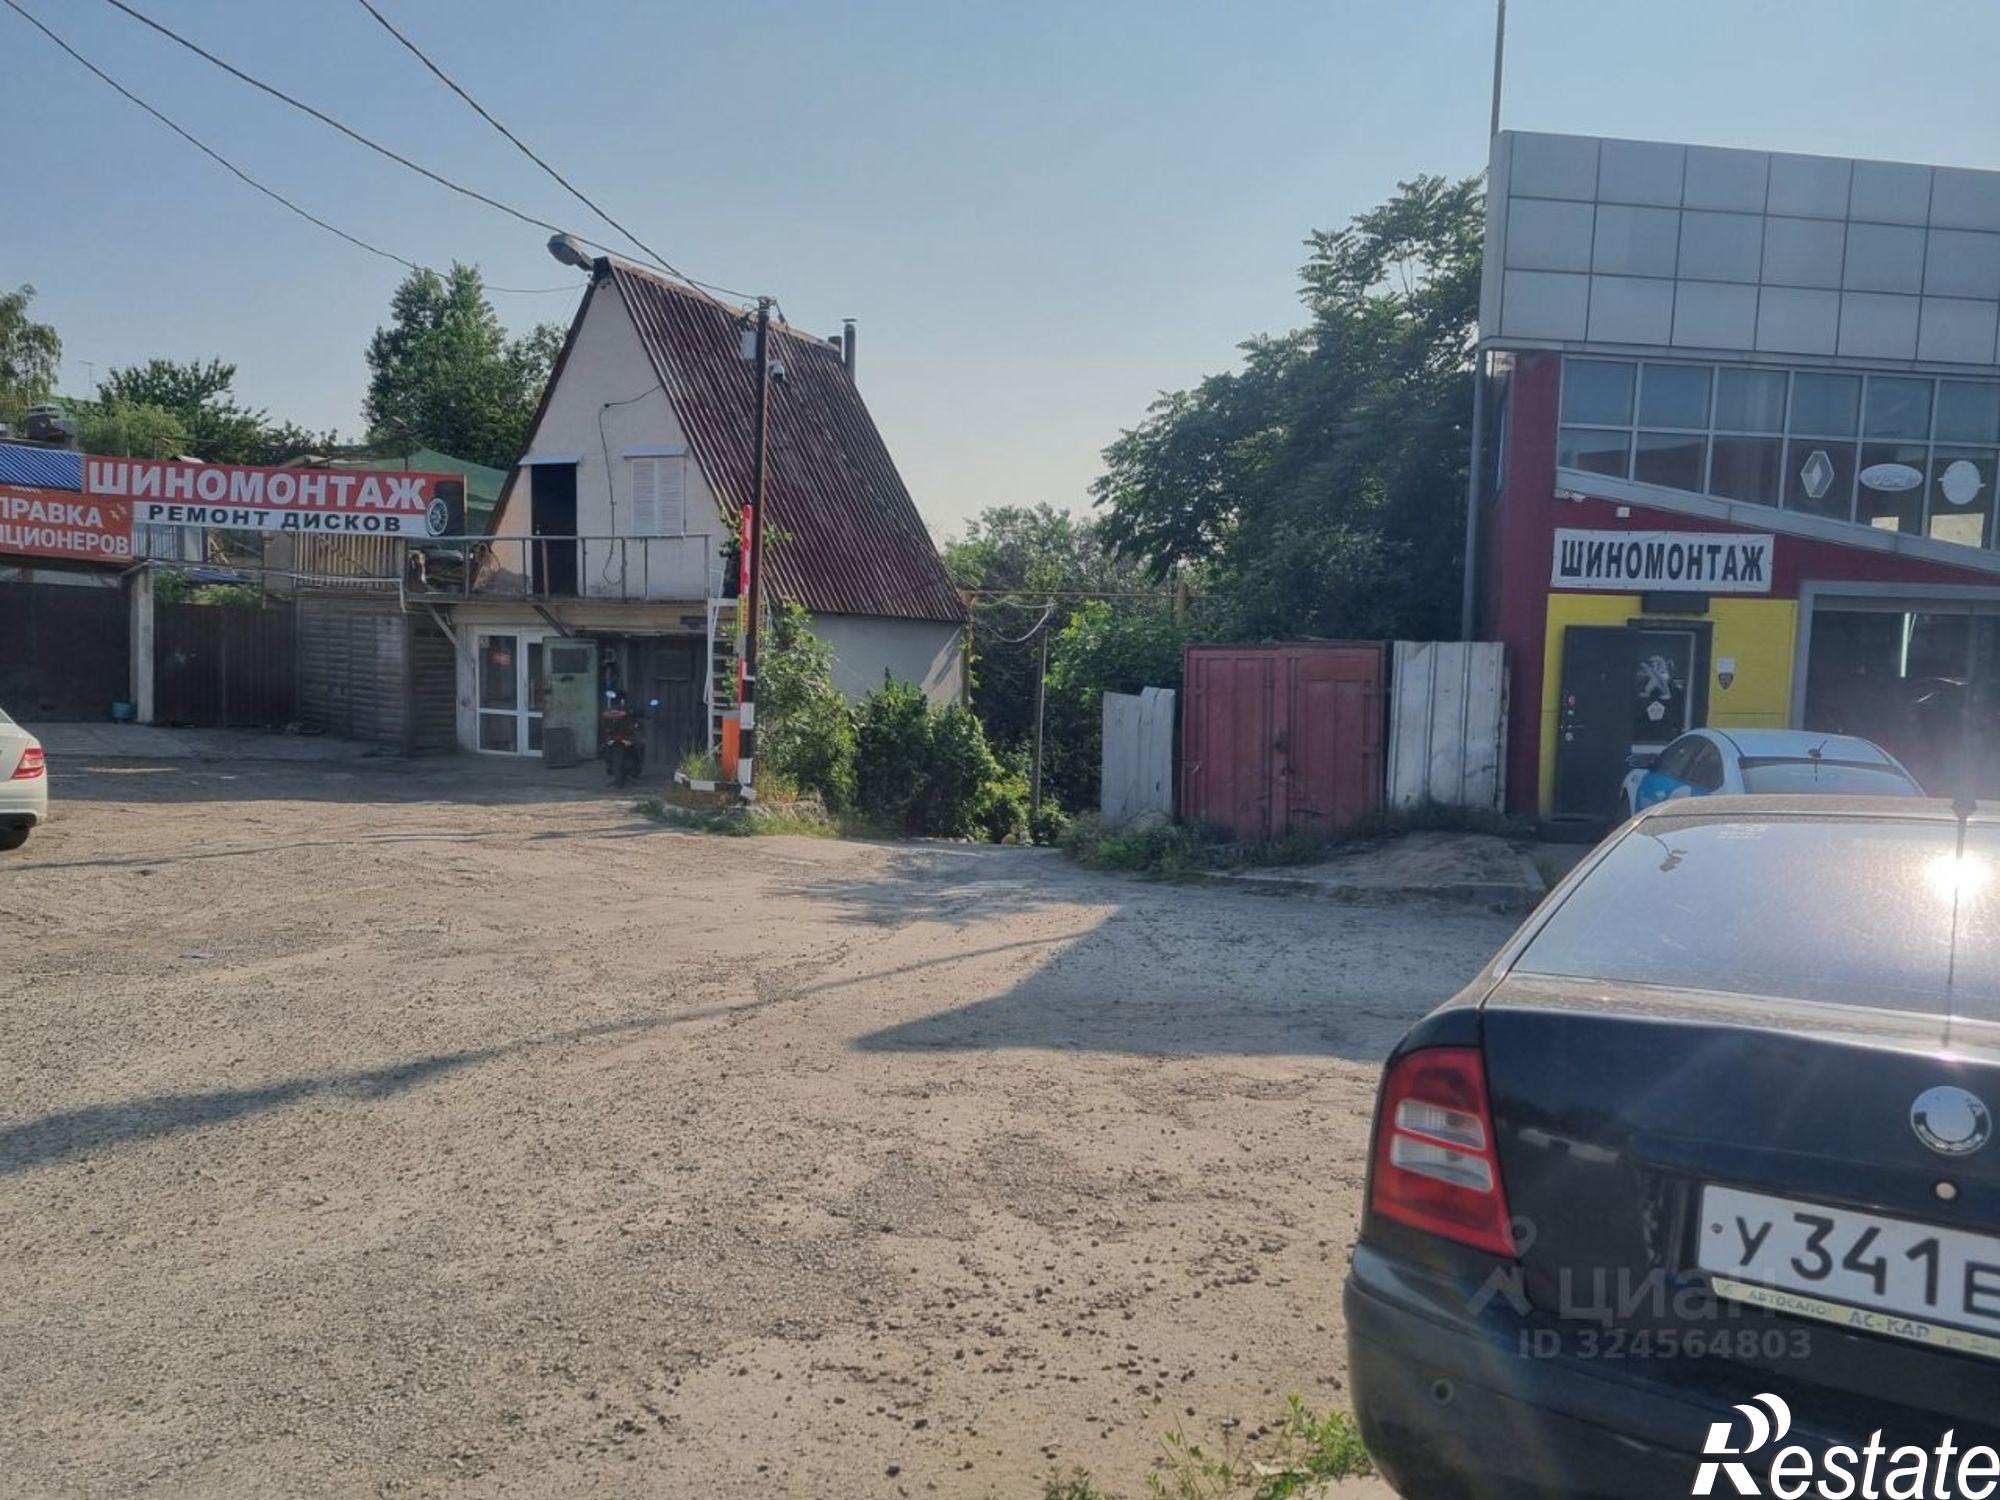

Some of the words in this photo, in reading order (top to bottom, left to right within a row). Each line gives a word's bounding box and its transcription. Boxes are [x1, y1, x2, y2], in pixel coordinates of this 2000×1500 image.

[89, 461, 427, 510] ШИНОМОНТАЖ
[149, 505, 269, 527] РЕМОНТ
[281, 511, 401, 532] ДИСКОВ
[0, 524, 128, 555] ЦИОНЕРОВ
[1560, 540, 1764, 582] ШИНОМОНТАЖ
